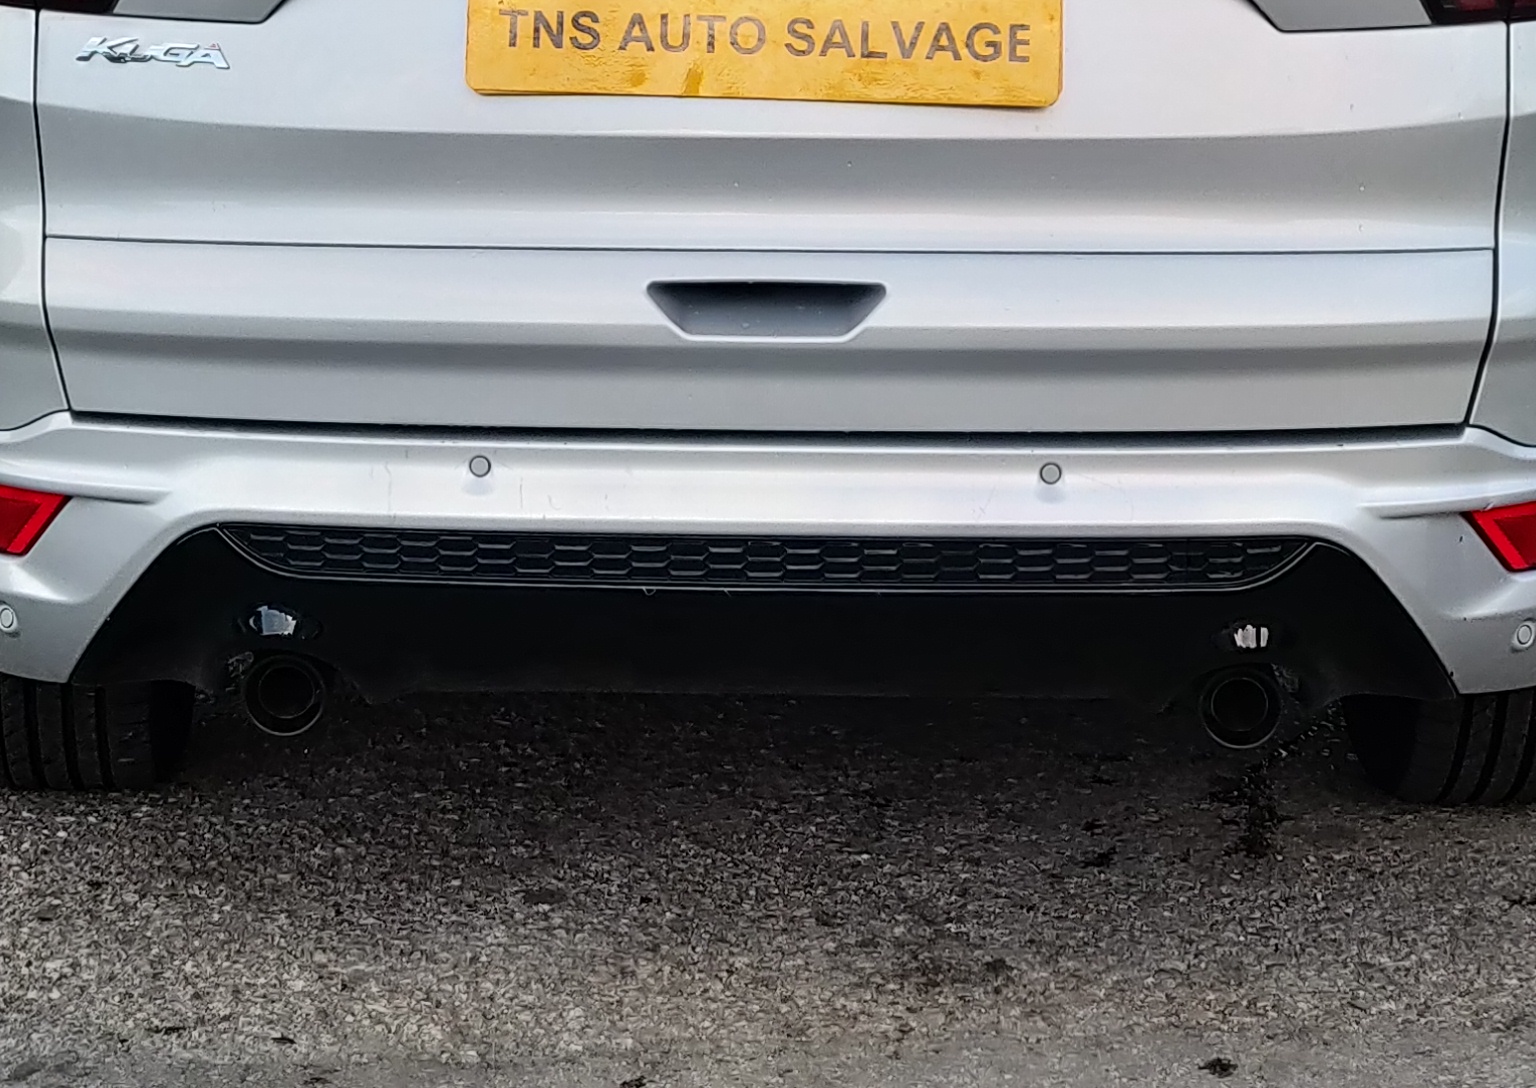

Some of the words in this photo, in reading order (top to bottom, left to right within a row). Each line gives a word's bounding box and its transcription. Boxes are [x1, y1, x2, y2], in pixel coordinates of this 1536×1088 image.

[499, 9, 600, 50] TNS
[617, 12, 766, 55] AUTO
[784, 17, 1031, 63] SALVAGE
